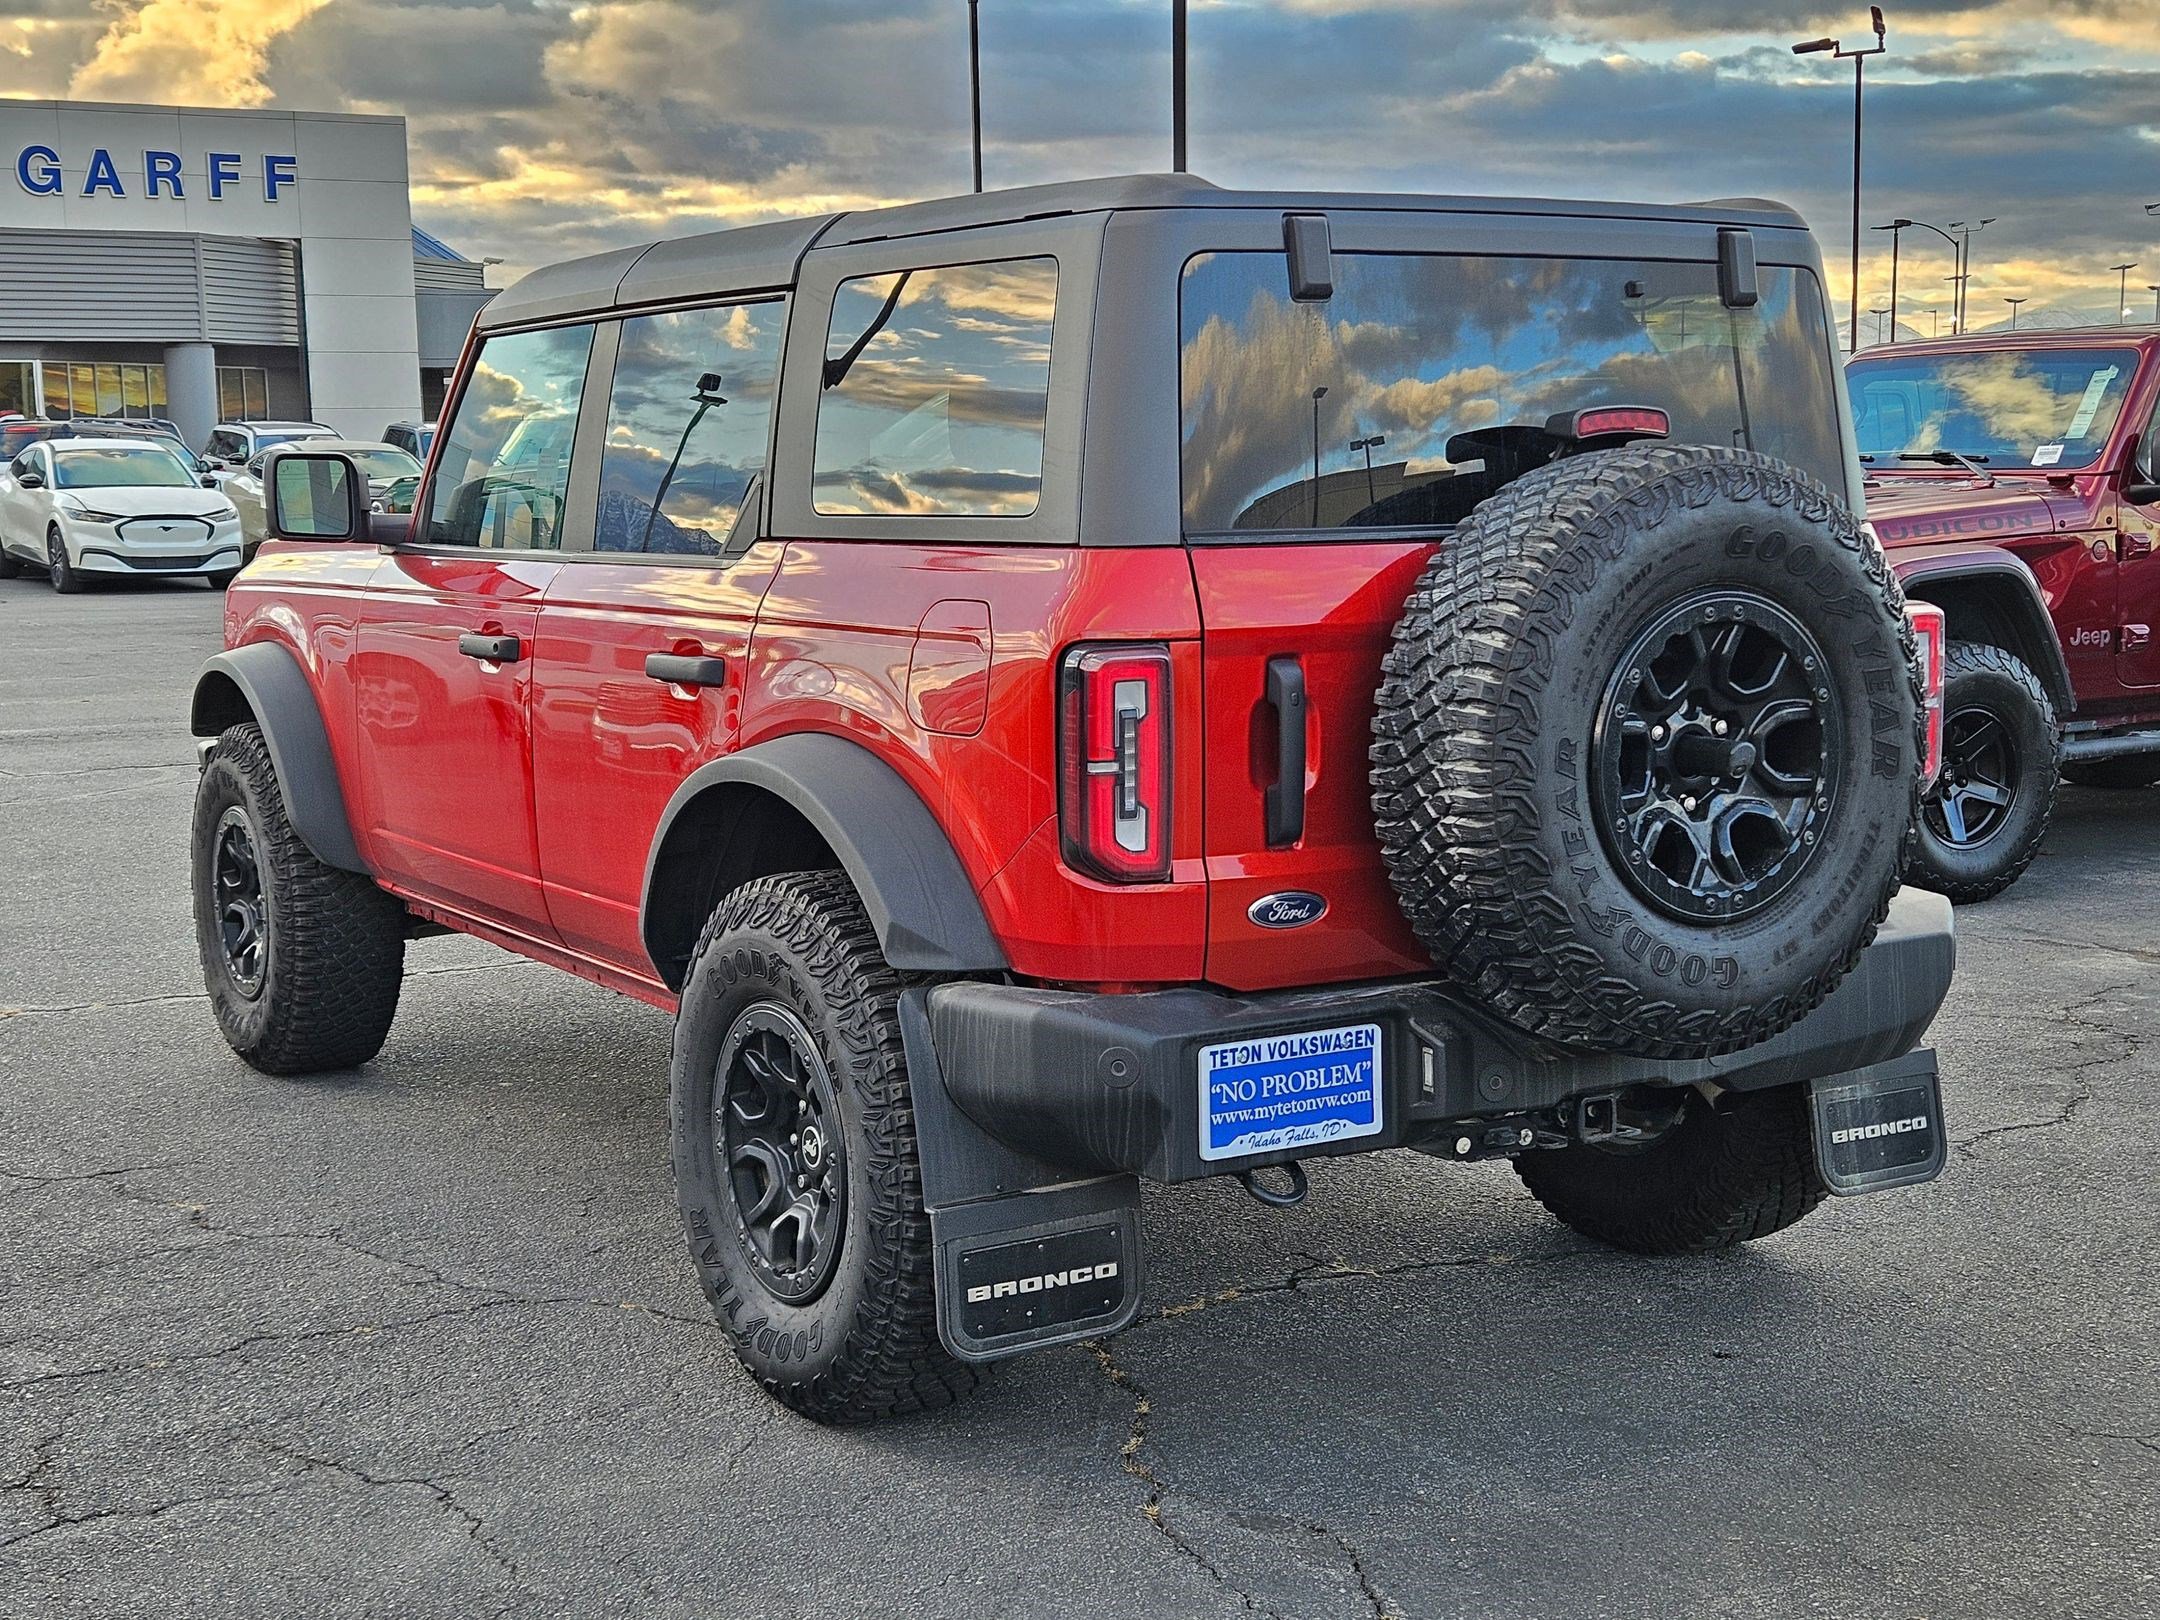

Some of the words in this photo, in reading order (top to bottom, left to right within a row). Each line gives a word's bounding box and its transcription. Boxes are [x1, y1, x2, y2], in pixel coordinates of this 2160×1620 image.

[15, 144, 297, 202] GARFF
[1881, 512, 2033, 541] UBICON
[2069, 627, 2111, 647] Jeep
[1268, 900, 1310, 922] Ford
[1210, 1044, 1262, 1068] TETON
[1267, 1028, 1375, 1060] VOLKSWAGEN
[1211, 1089, 1371, 1126] www.mytetonvw.com
[1248, 1134, 1282, 1150] Idaho
[1831, 1115, 1928, 1145] BRONCO
[967, 1262, 1118, 1303] BRONCO
